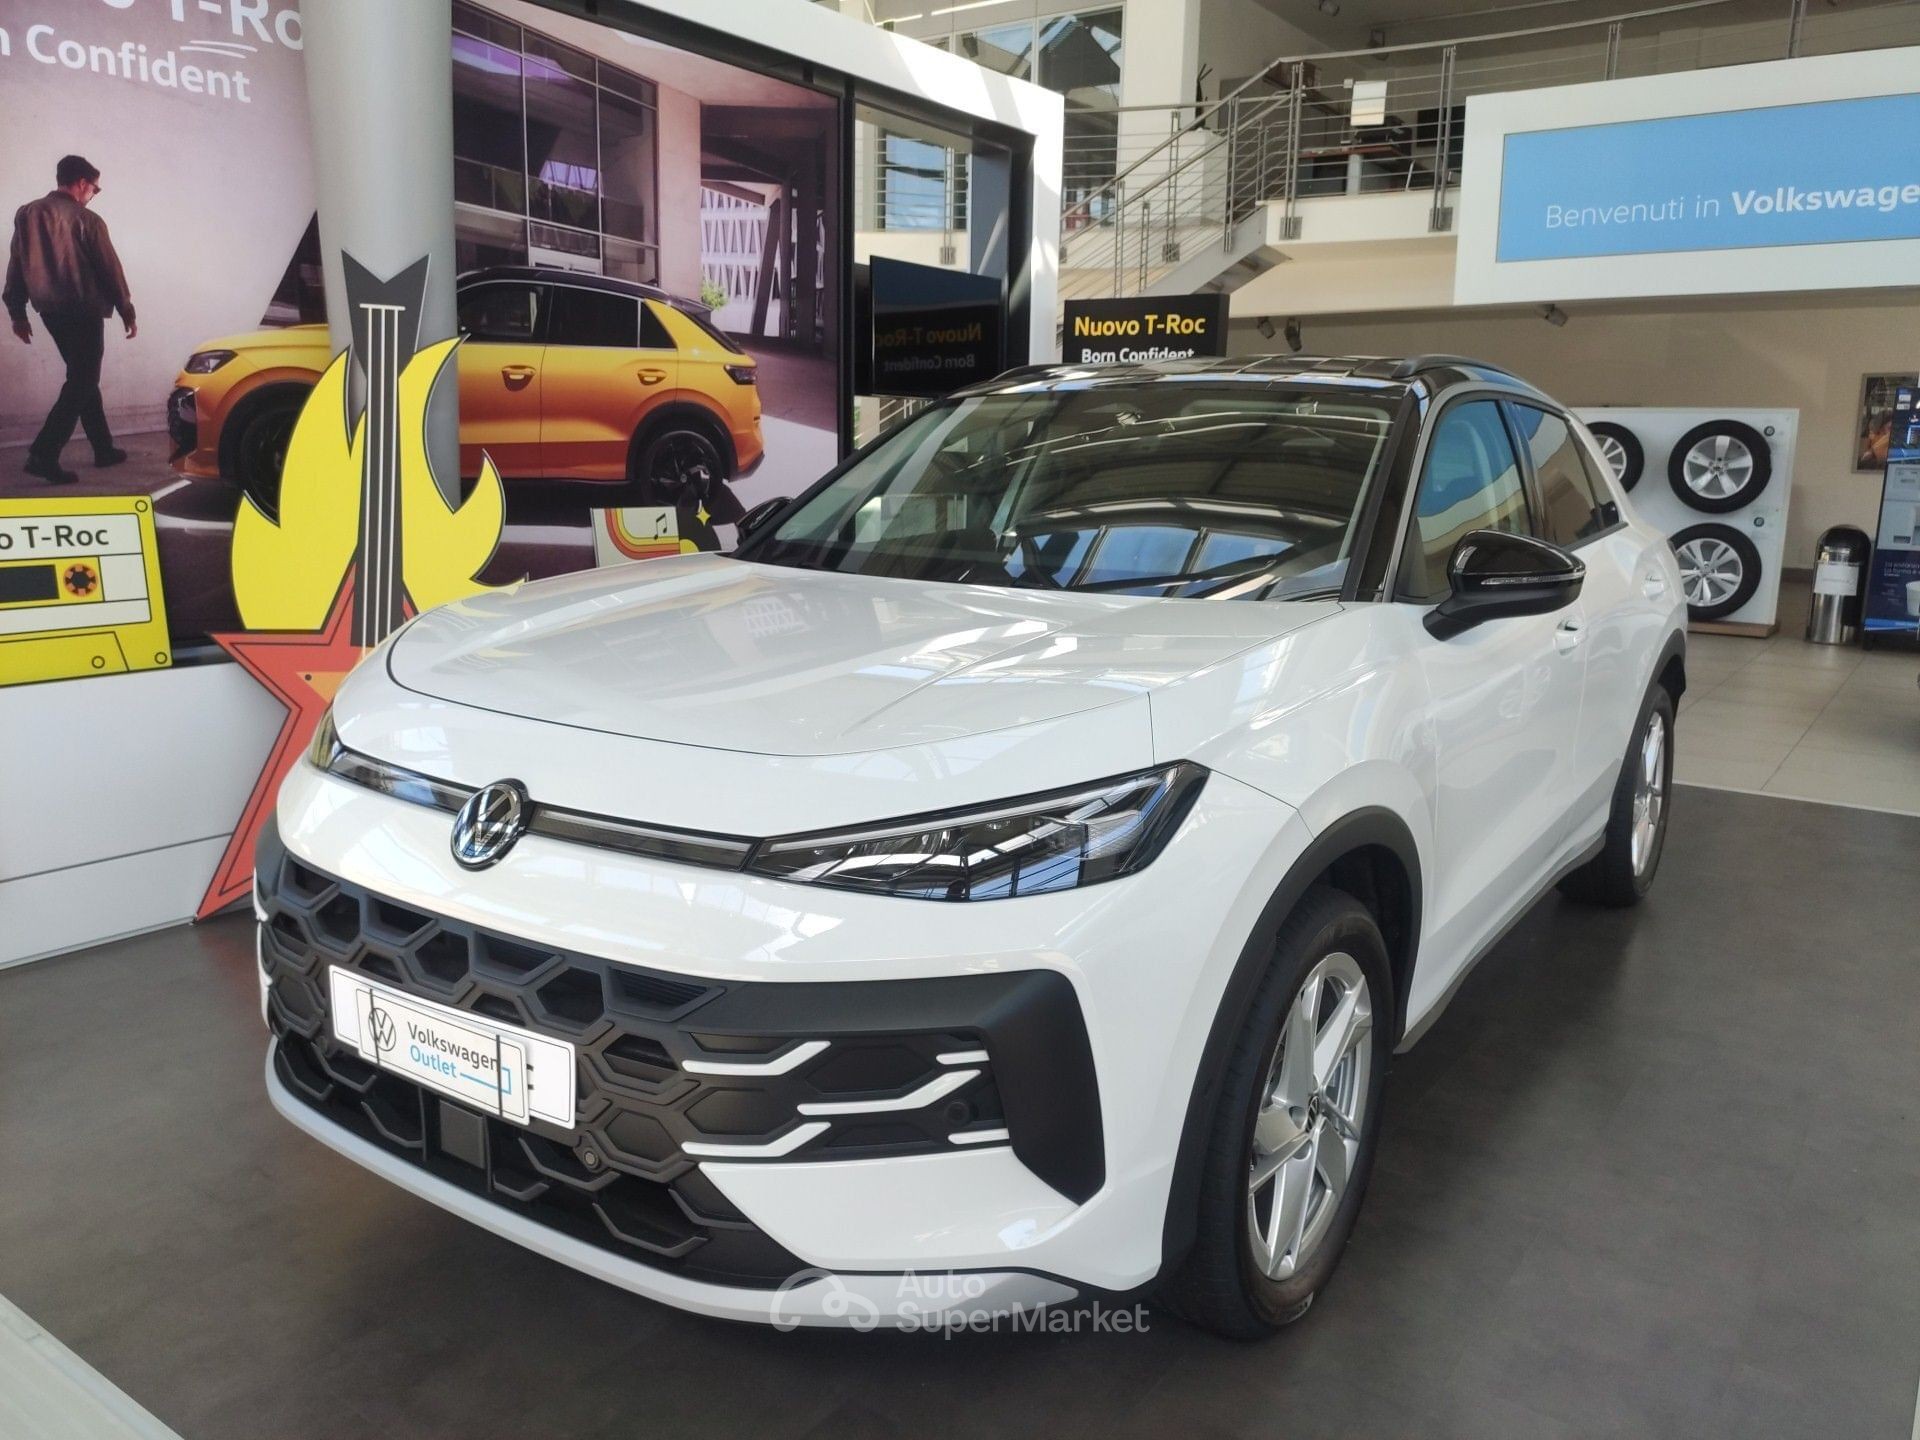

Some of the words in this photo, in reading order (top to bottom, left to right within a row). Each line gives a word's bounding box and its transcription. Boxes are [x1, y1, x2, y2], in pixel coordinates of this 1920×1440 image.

[26, 24, 251, 103] Confident
[1545, 197, 1684, 229] Benvenuti
[1695, 195, 1720, 219] in
[1731, 183, 1920, 216] Volkswage
[1074, 316, 1140, 337] Nuovo
[1144, 314, 1206, 335] T-Roc
[1081, 348, 1116, 363] Born
[20, 525, 110, 549] T-Roc
[407, 1021, 500, 1073] Volkswagen
[410, 1043, 458, 1079] Outlet
